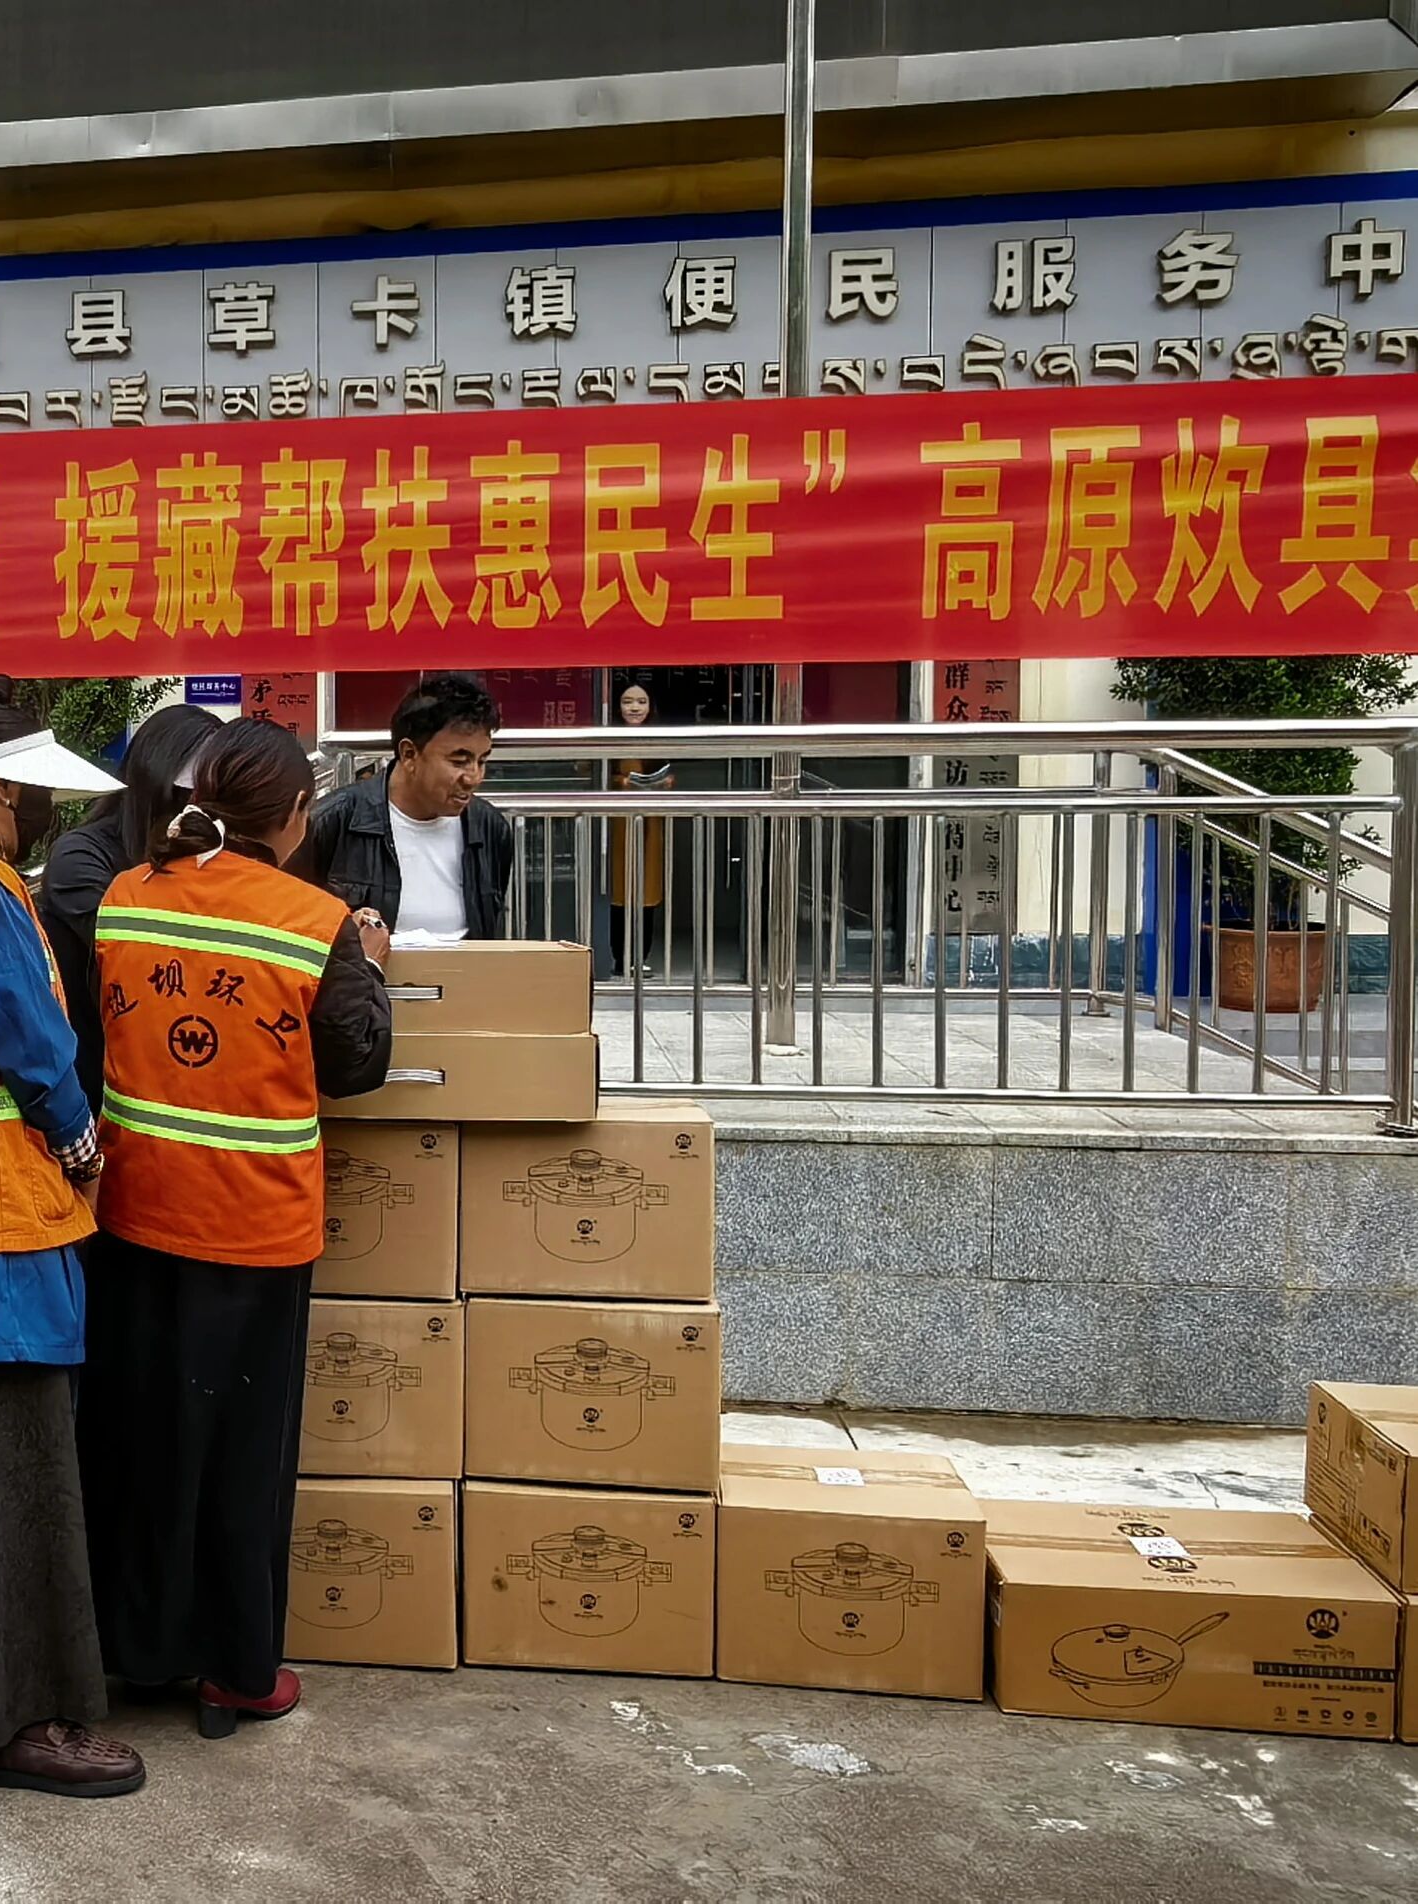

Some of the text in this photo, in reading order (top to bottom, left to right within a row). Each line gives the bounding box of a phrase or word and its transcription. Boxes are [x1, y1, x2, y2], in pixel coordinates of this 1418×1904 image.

[55, 430, 847, 642] 援藏帮扶惠民生”
[919, 415, 1418, 621] 高原炊具
